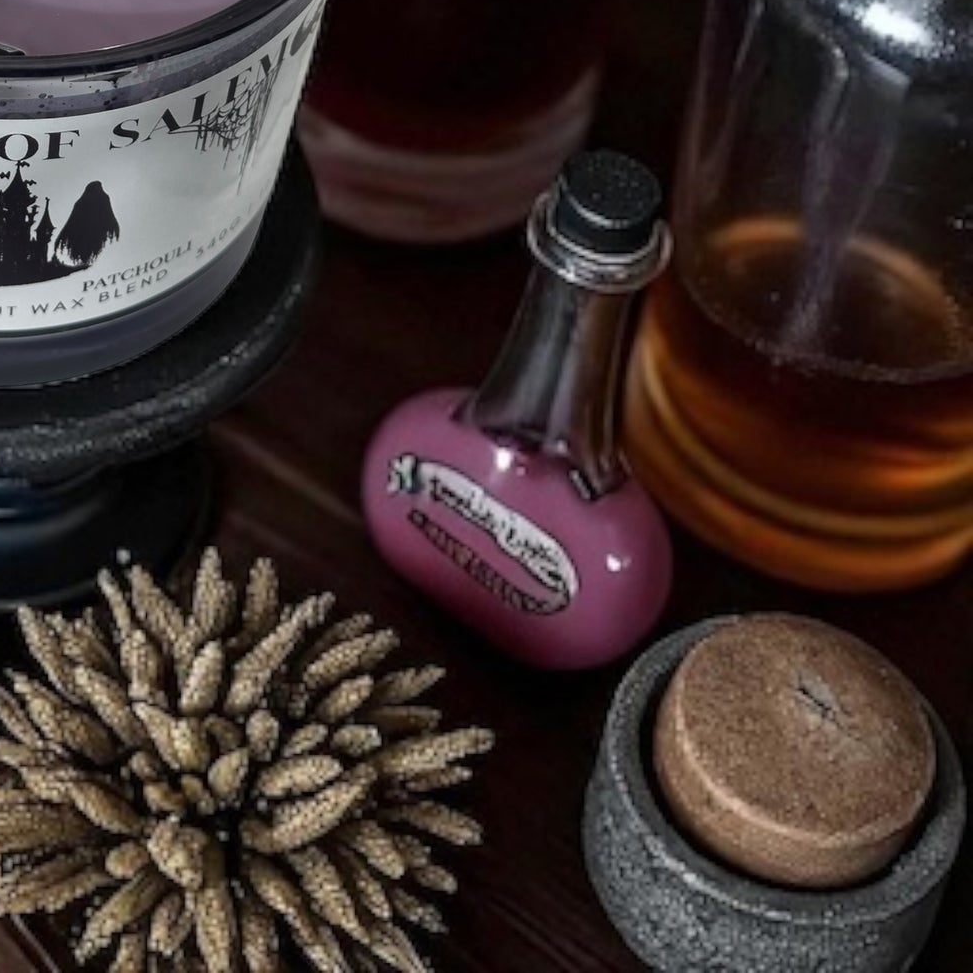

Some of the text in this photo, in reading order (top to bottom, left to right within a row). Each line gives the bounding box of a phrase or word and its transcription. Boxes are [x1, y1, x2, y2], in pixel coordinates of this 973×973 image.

[108, 33, 291, 151] SALEM
[31, 297, 85, 315] WAX
[98, 268, 169, 304] BLEND
[82, 239, 193, 293] PATCHOULI
